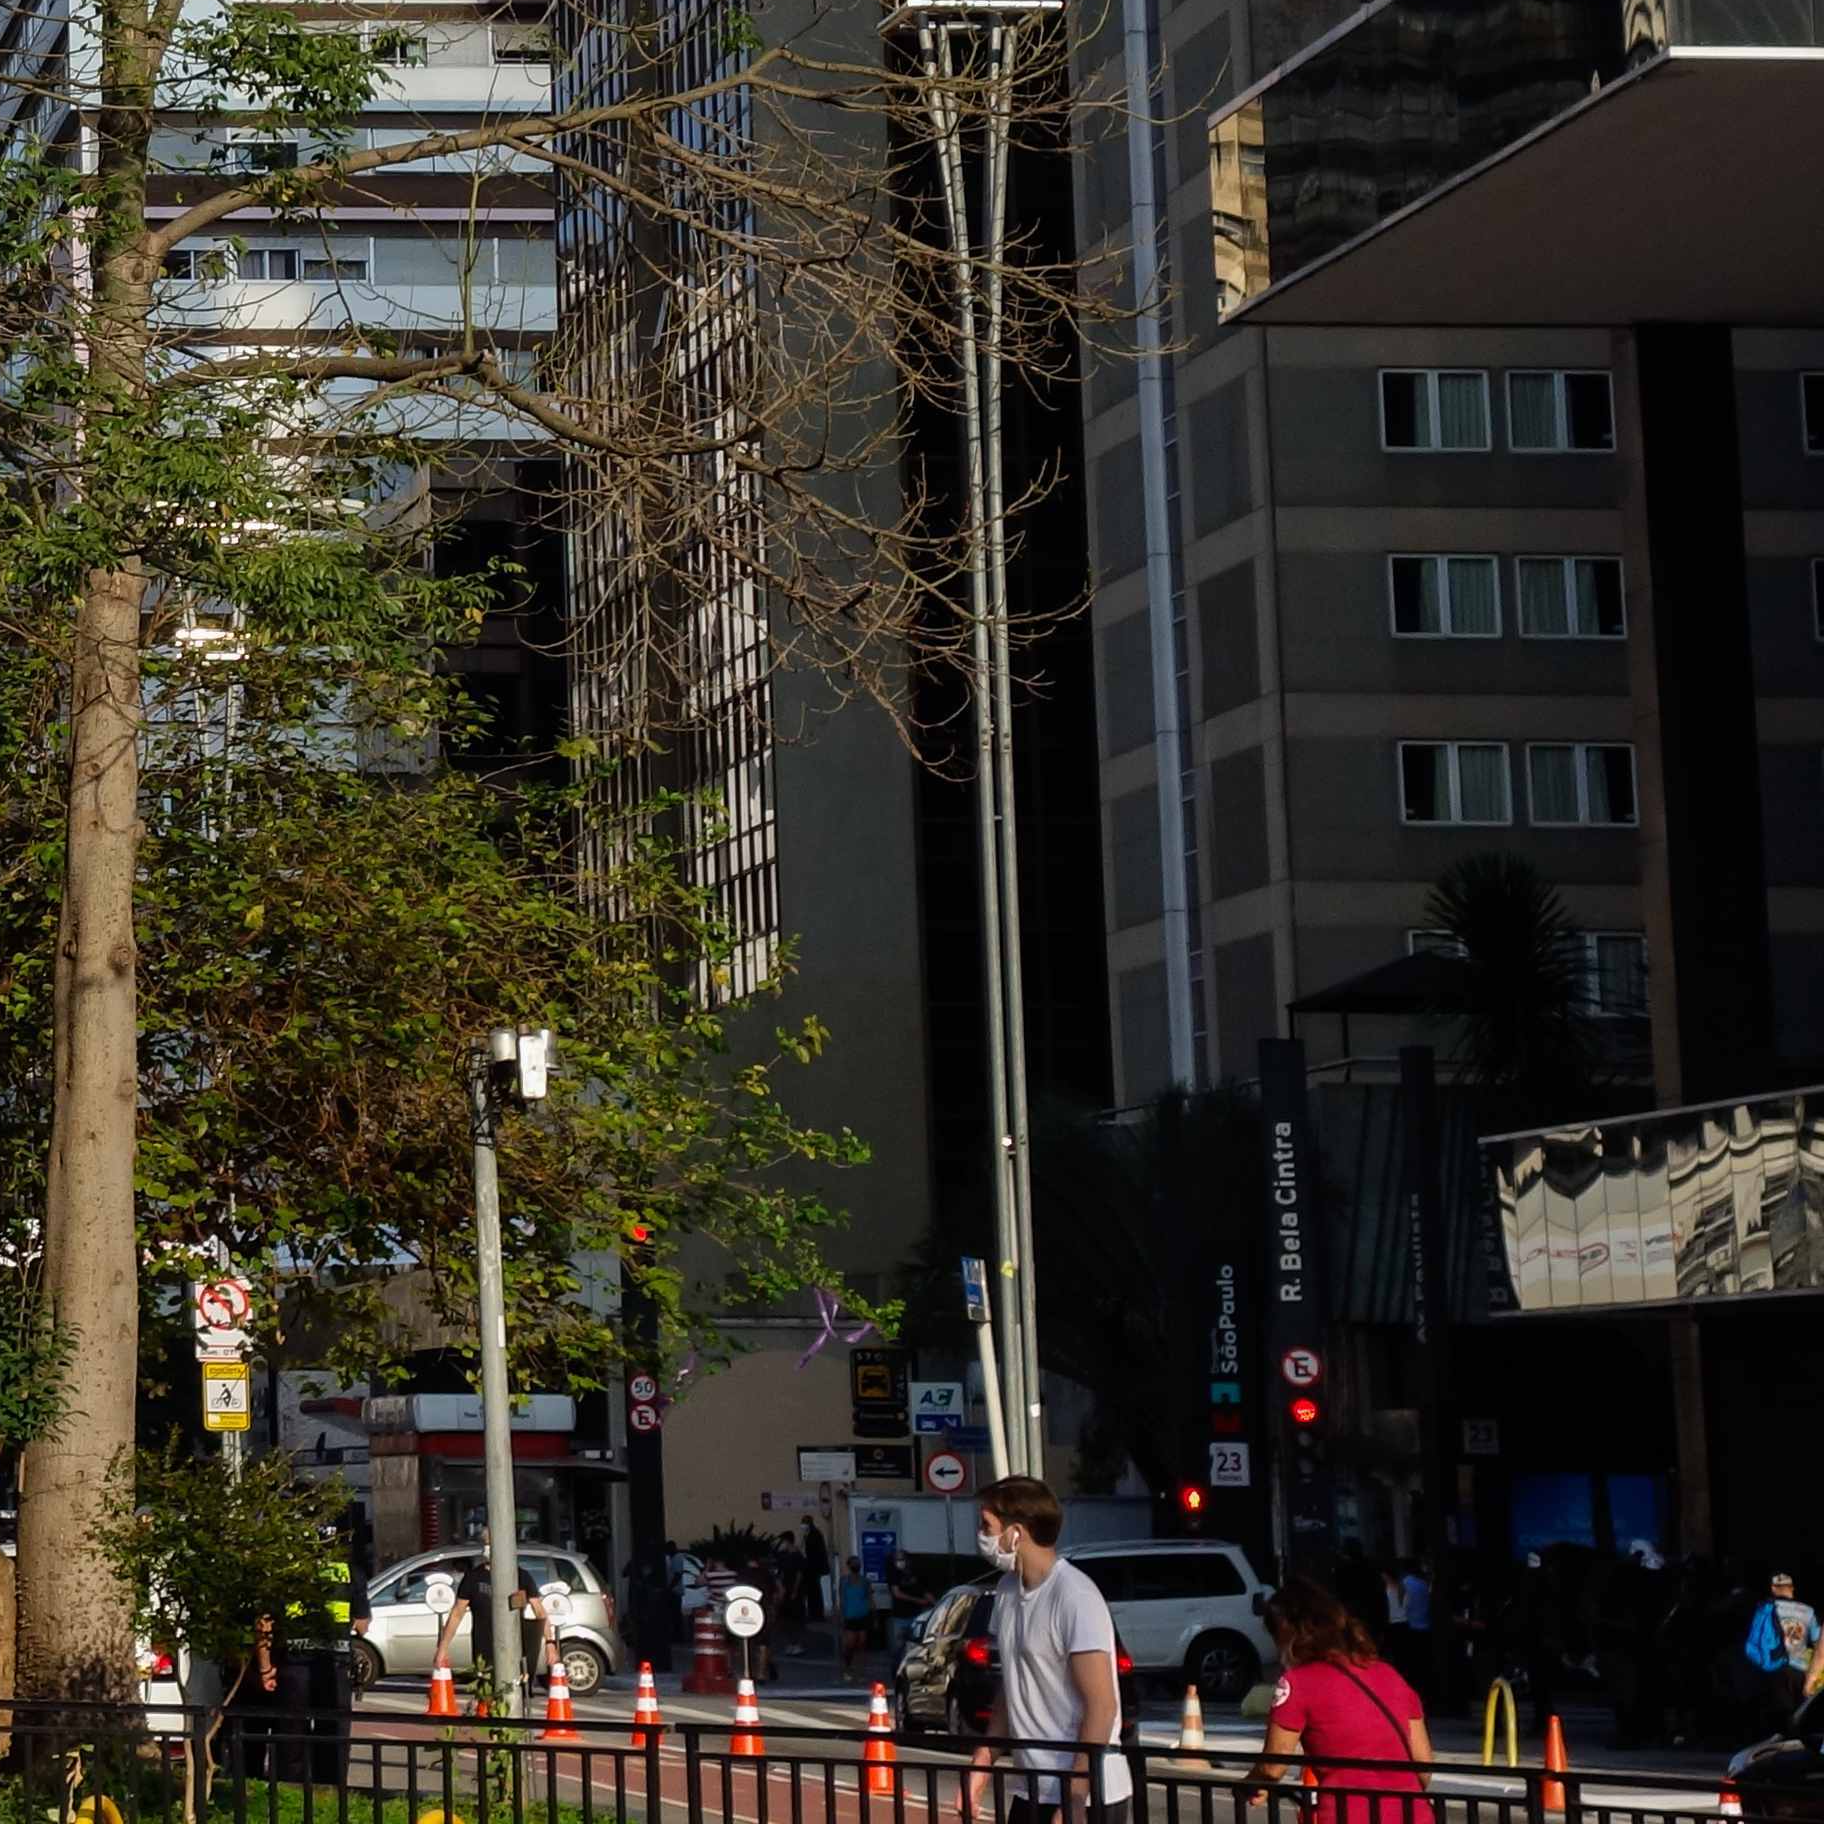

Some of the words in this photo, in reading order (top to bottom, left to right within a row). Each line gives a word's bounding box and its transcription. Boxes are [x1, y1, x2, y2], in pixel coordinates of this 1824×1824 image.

[1273, 1120, 1298, 1206] Cintra
[1278, 1213, 1305, 1272] Bela
[1280, 1279, 1304, 1303] R.
[635, 1382, 652, 1394] 50
[1217, 1452, 1242, 1473] 23
